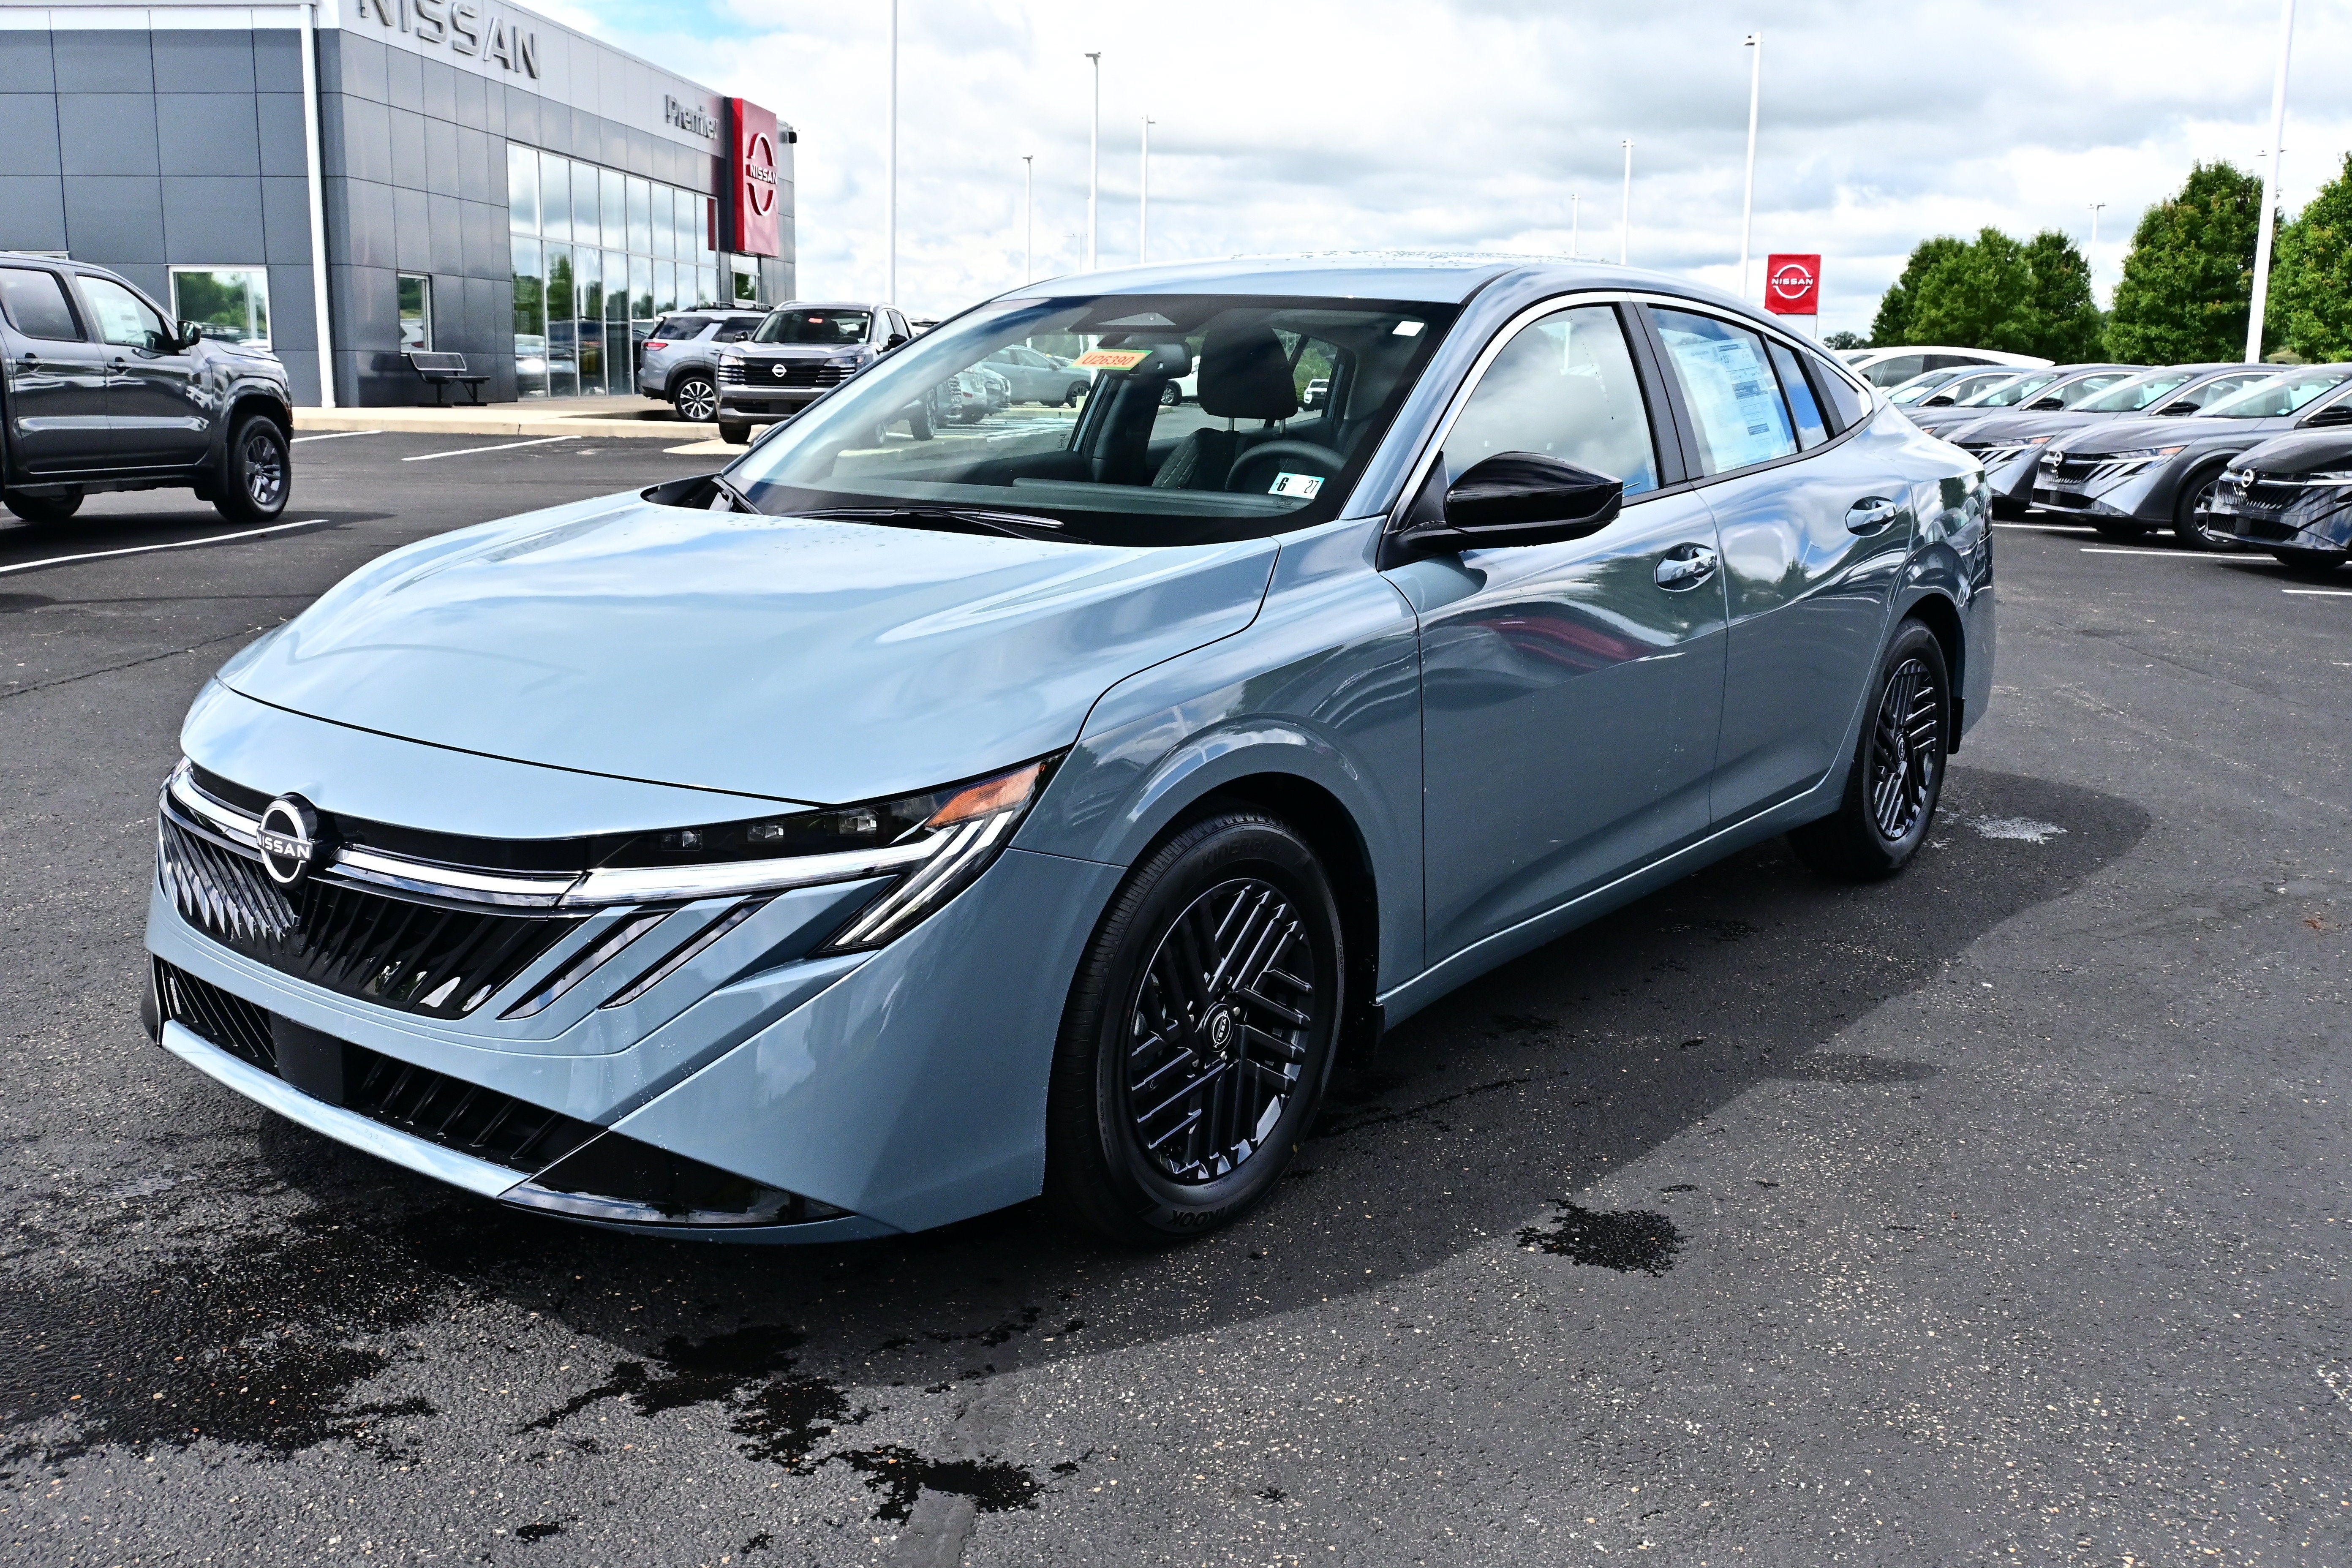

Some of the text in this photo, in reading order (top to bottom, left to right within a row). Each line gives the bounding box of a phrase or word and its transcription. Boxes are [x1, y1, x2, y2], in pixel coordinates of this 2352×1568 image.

[750, 164, 778, 185] NISSAN
[1082, 355, 1135, 365] U26390
[1277, 477, 1320, 494] 6 27
[256, 831, 310, 859] NISSAN
